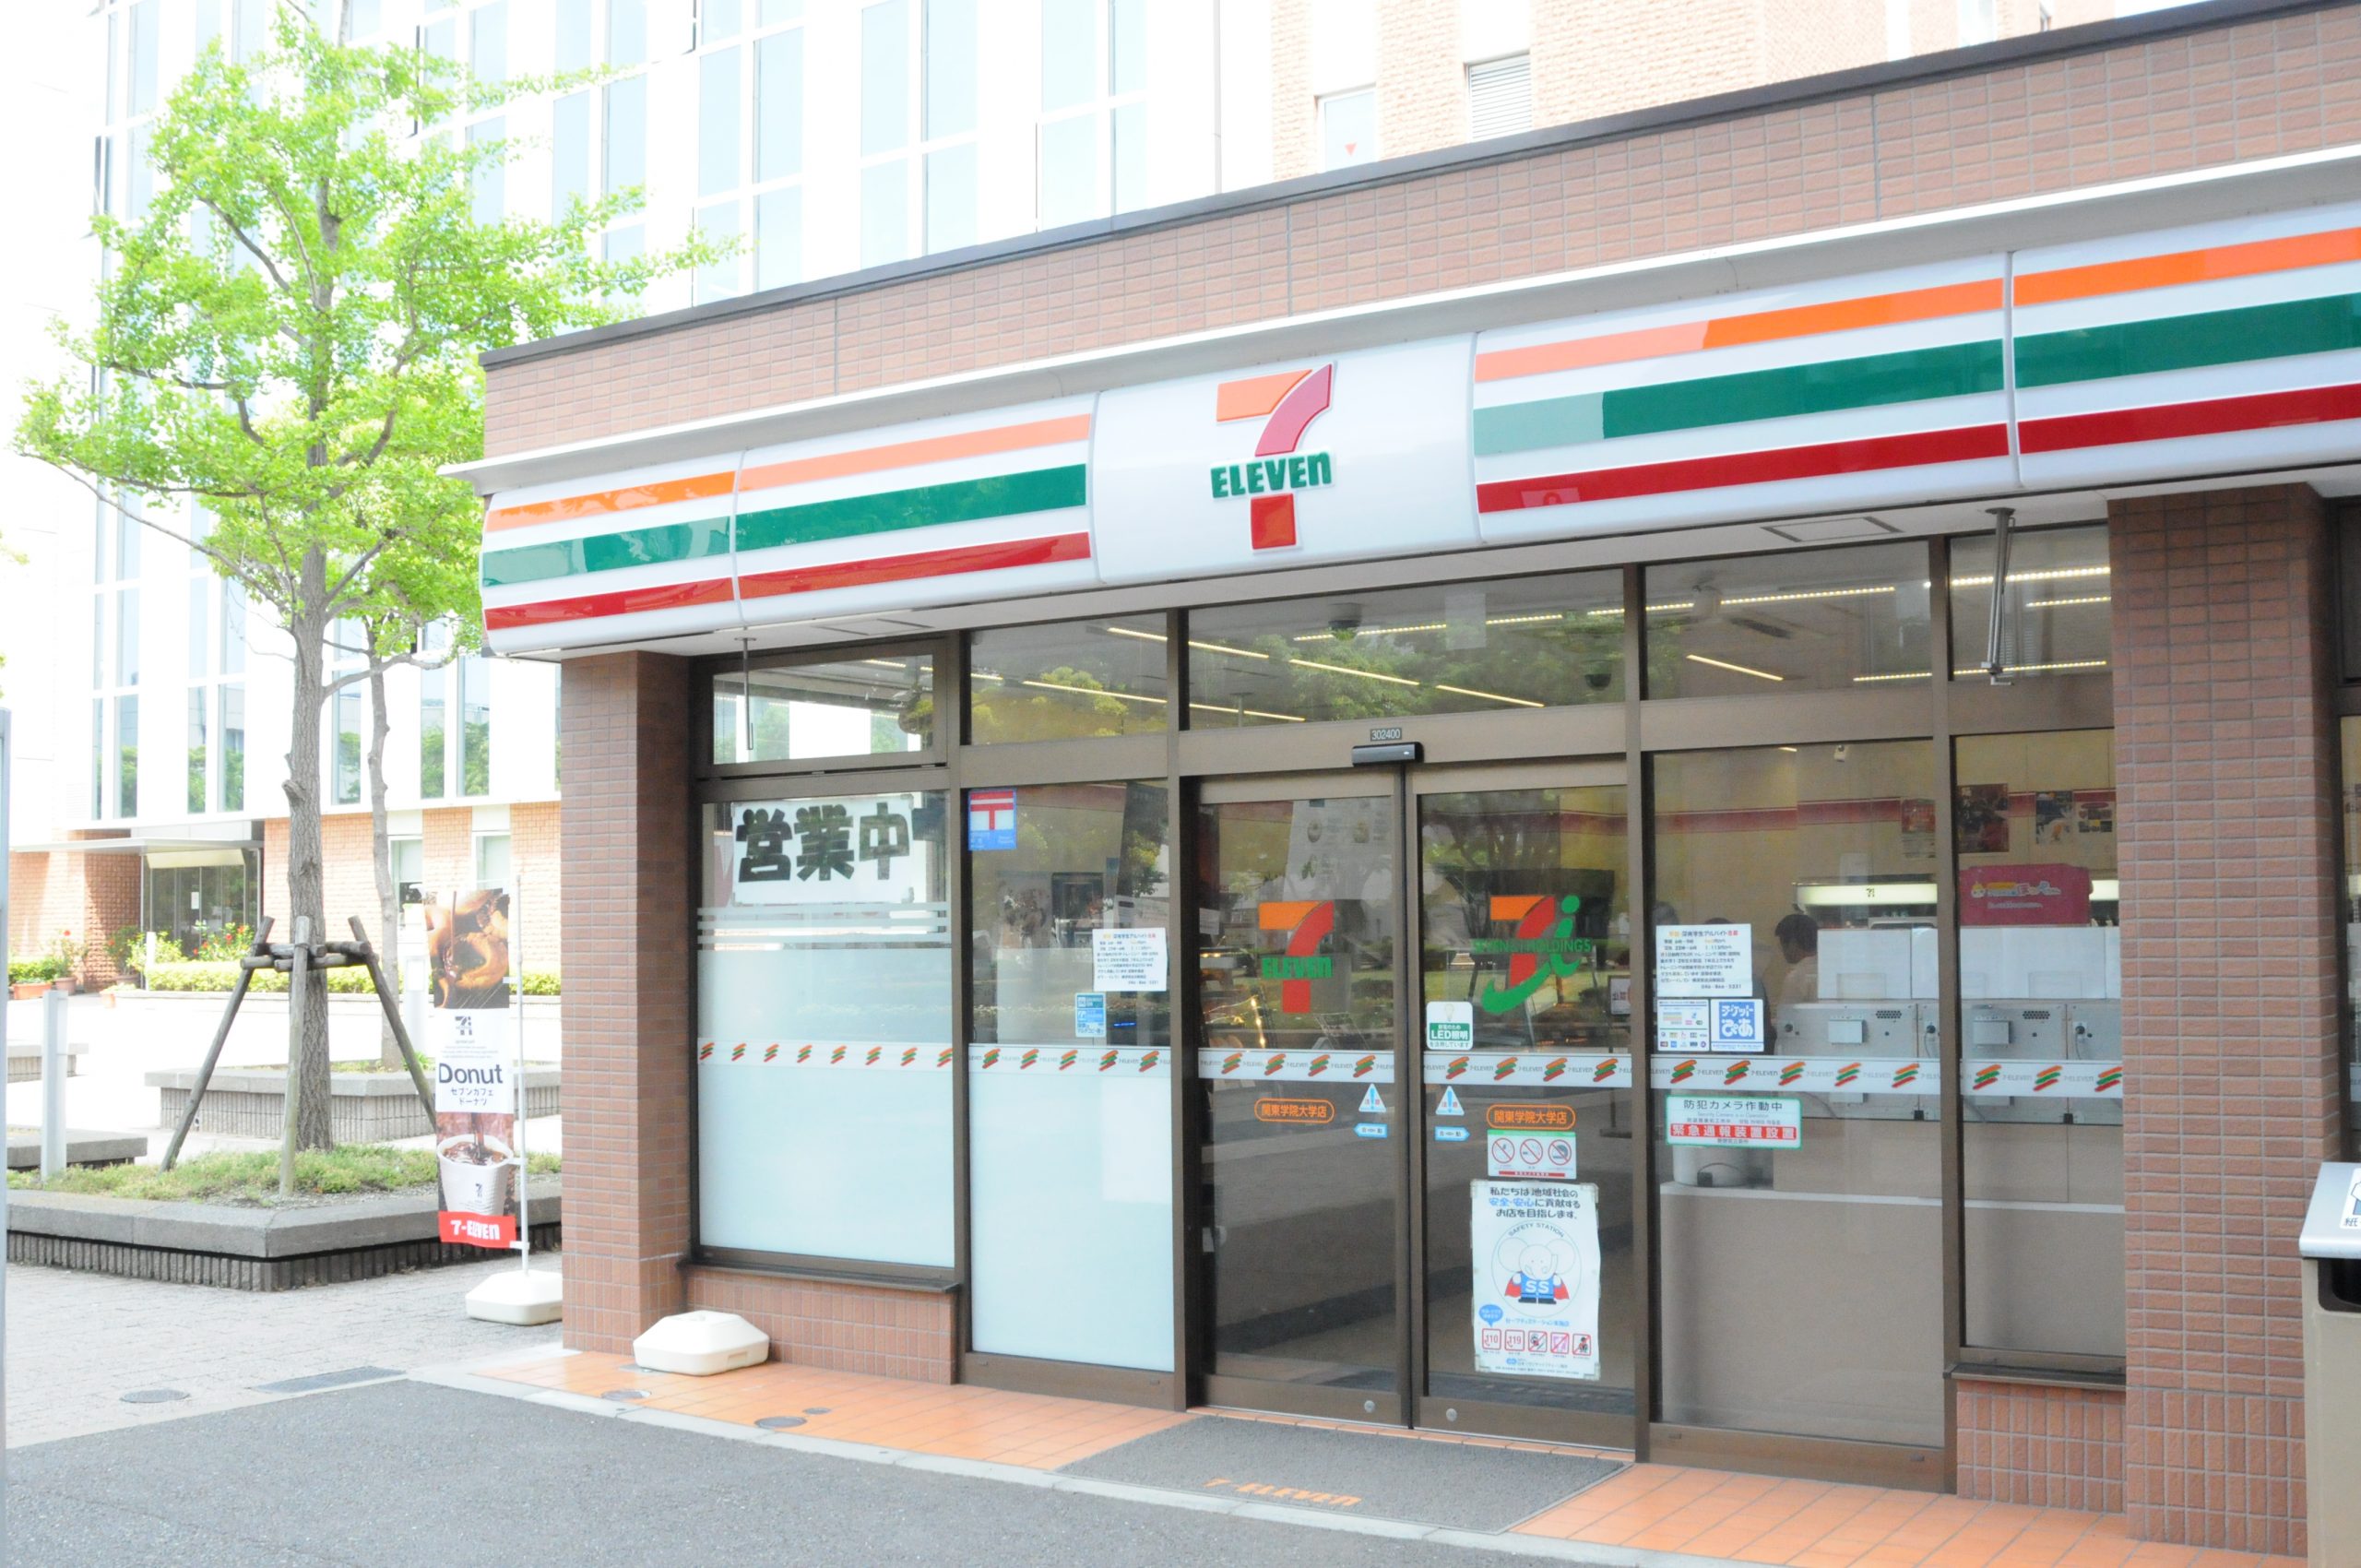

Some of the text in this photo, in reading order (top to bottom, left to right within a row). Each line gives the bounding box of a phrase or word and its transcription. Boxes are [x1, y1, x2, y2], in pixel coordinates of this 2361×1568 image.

[1371, 729, 1401, 740] 302400
[736, 802, 910, 883] 営業中
[1721, 1004, 1753, 1017] チケット
[1721, 1017, 1753, 1037] ぴあ
[1430, 1029, 1468, 1040] LED照明
[439, 1063, 504, 1084] Donut
[451, 1087, 494, 1097] セブンカフェ
[459, 1098, 487, 1106] ドーナツ
[1683, 1099, 1783, 1112] 防犯カメラ作動中
[1261, 1104, 1327, 1118] 関東学院大学店
[1494, 1110, 1568, 1124] 関東学院大学店
[1672, 1124, 1794, 1139] 緊急通報装置設置
[1489, 1186, 1578, 1198] 私たちは地域社会の
[1509, 1222, 1565, 1238] SAFETY STATION
[1525, 1280, 1549, 1293] SS
